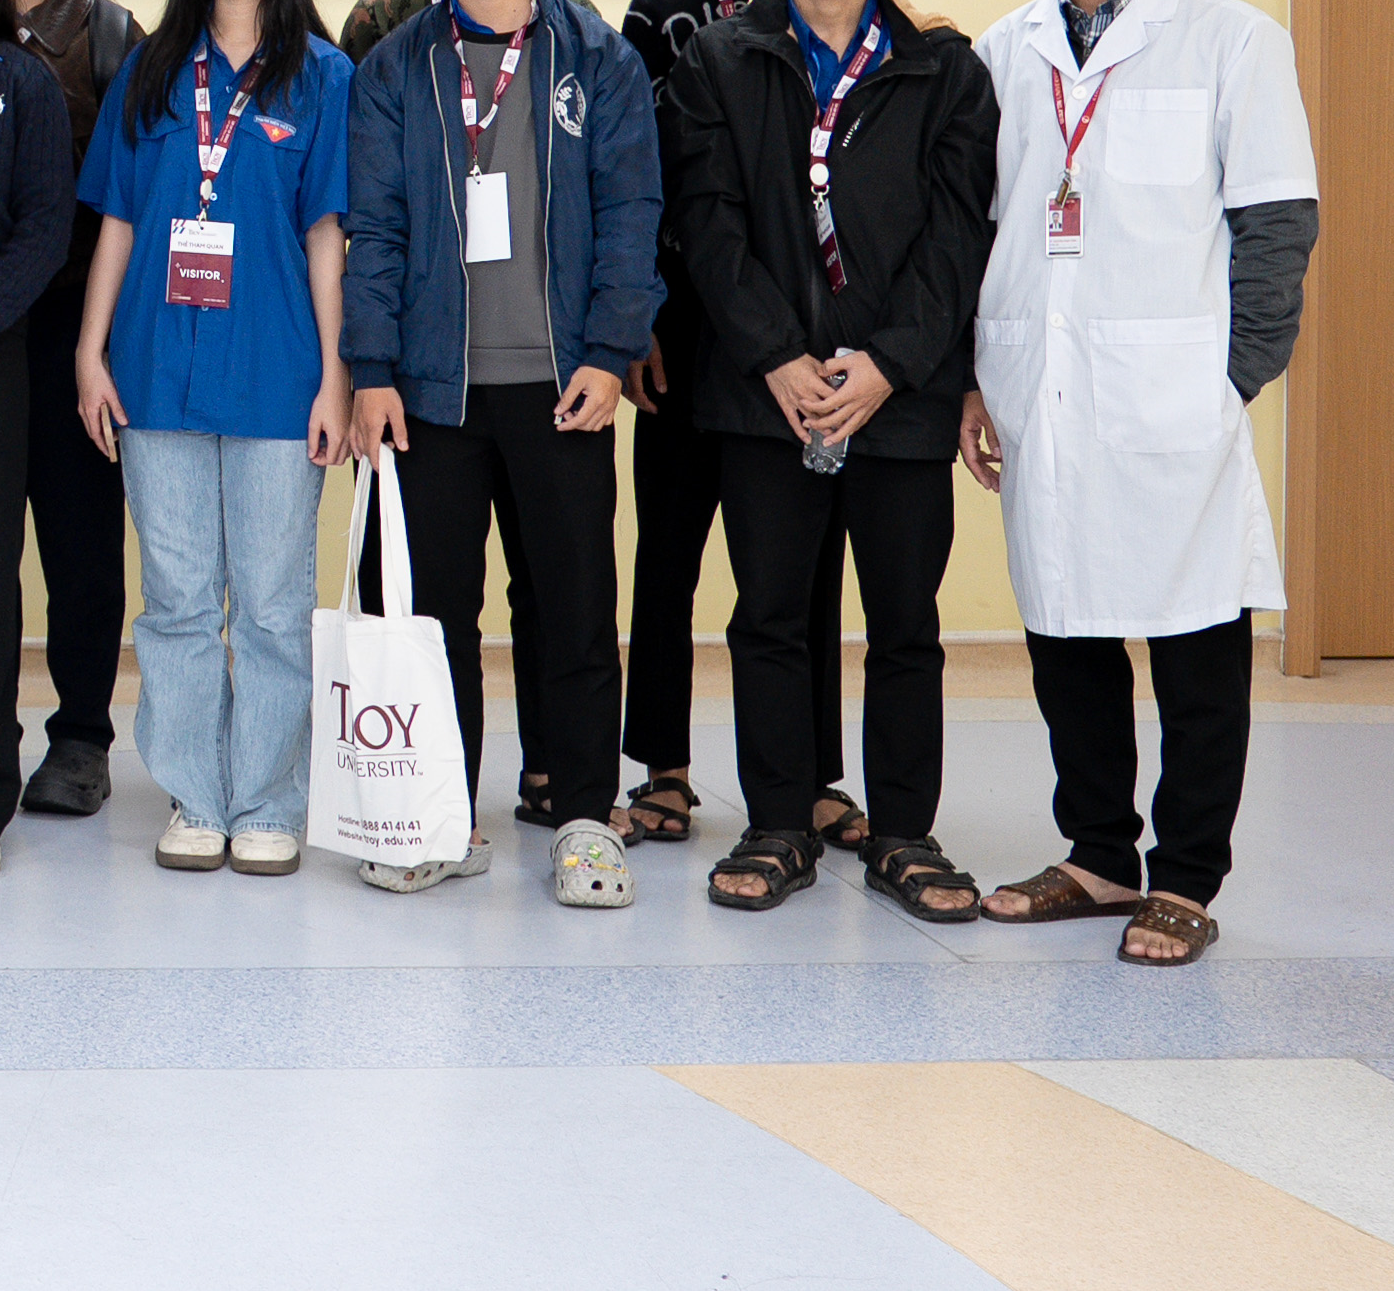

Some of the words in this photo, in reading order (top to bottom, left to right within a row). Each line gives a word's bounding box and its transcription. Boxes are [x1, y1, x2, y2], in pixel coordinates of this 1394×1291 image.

[179, 267, 221, 280] VISITOR
[330, 680, 422, 751] TOY
[336, 752, 418, 778] UNERSITY
[360, 819, 380, 832] 888
[408, 820, 421, 830] 41
